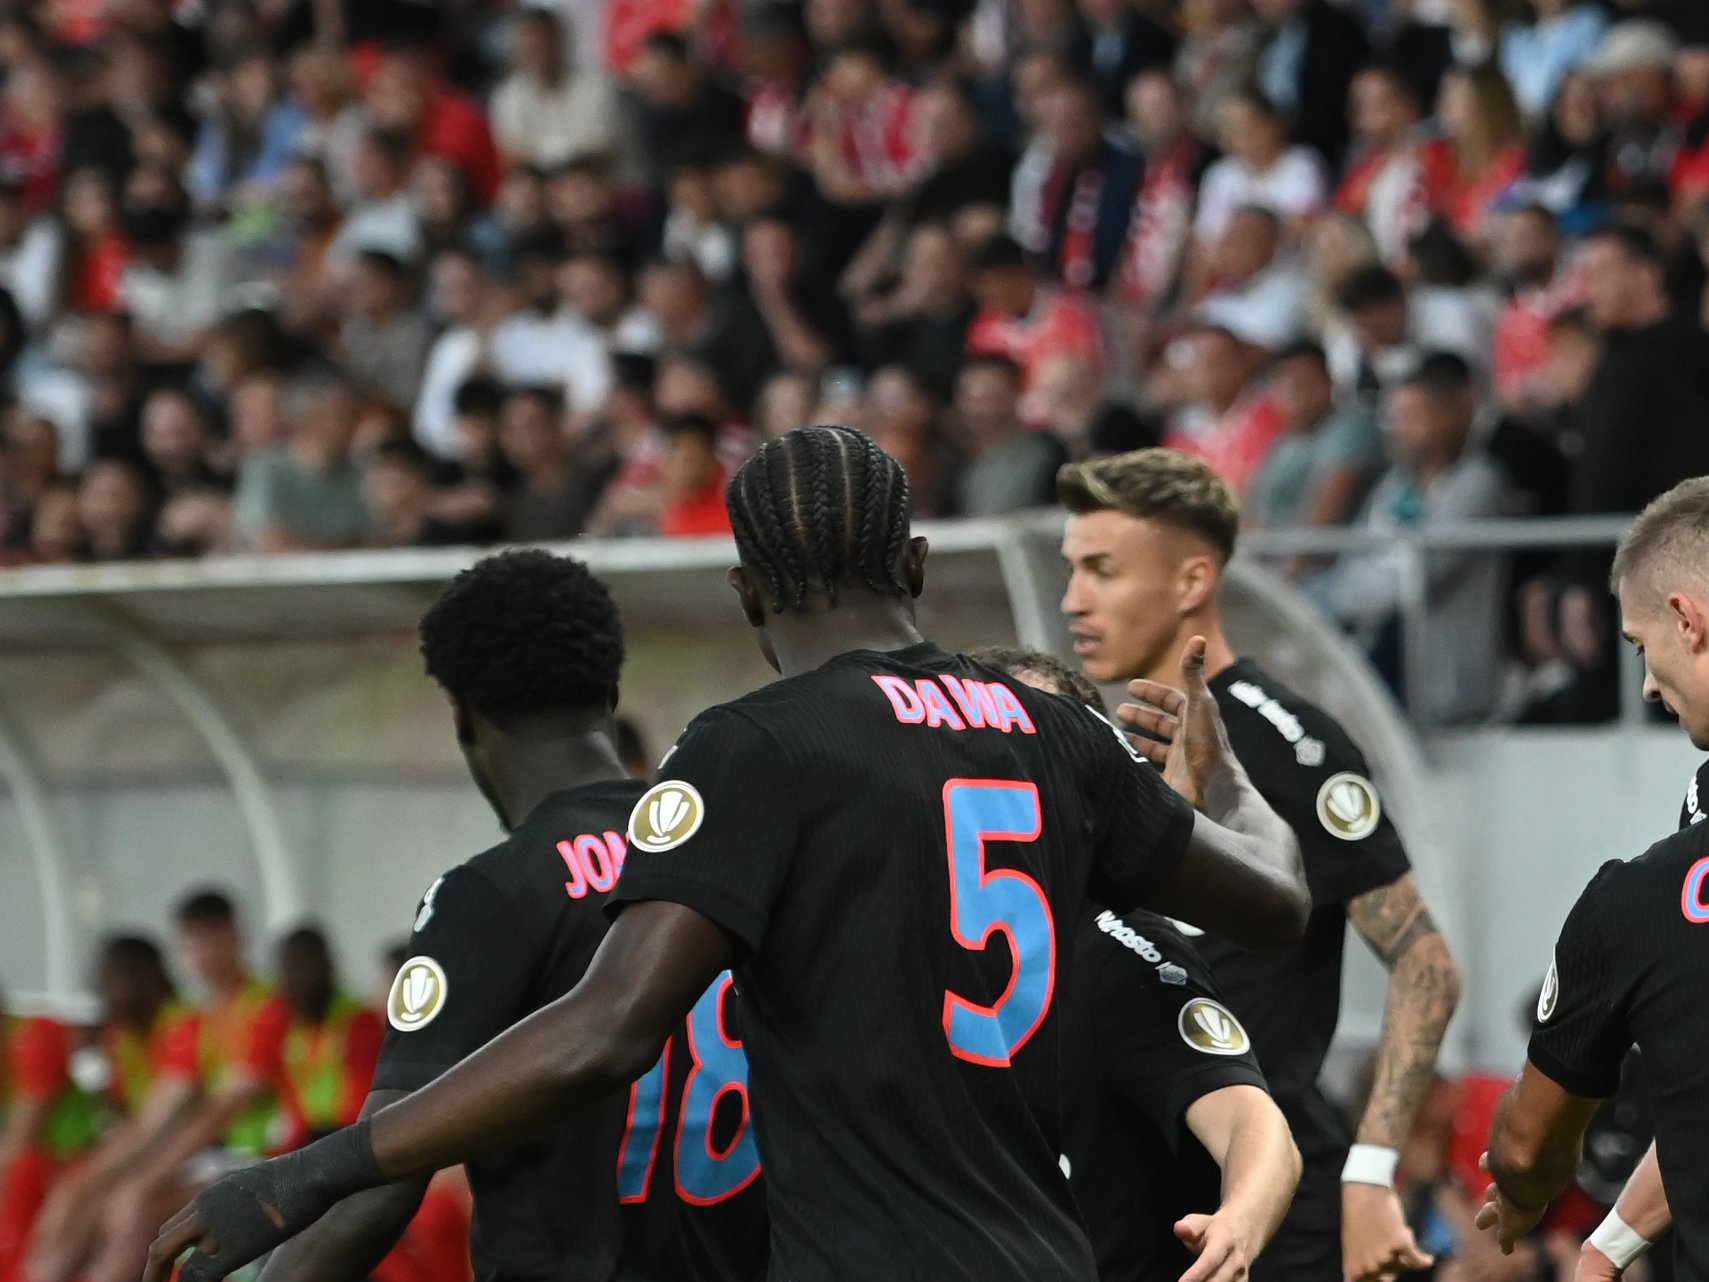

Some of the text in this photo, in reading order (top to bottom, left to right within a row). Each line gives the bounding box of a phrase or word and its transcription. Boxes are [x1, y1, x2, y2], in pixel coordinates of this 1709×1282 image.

[872, 674, 1036, 734] DAWA
[942, 777, 1056, 1068] 5
[617, 970, 762, 1206] 18
